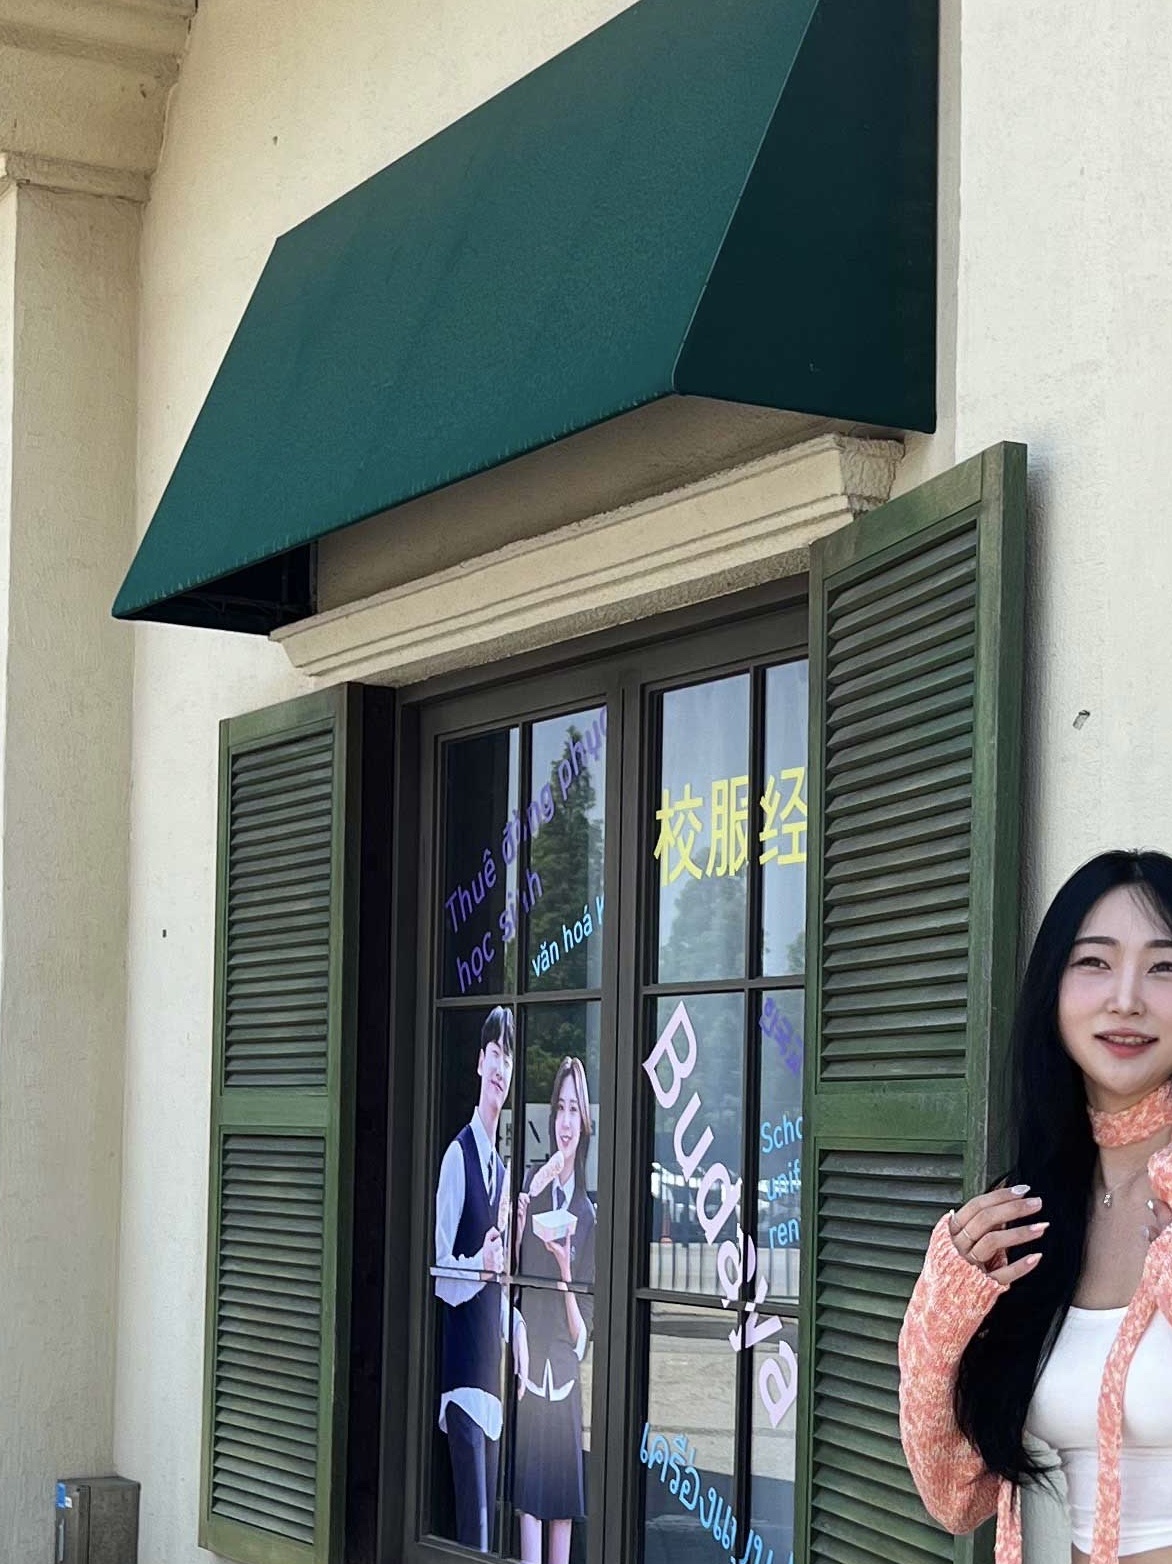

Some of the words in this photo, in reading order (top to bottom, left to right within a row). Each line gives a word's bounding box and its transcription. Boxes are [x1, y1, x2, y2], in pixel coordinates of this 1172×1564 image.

[445, 848, 497, 934] Thuê
[456, 931, 496, 994] học
[532, 941, 560, 978] văn
[562, 904, 593, 953] hoá
